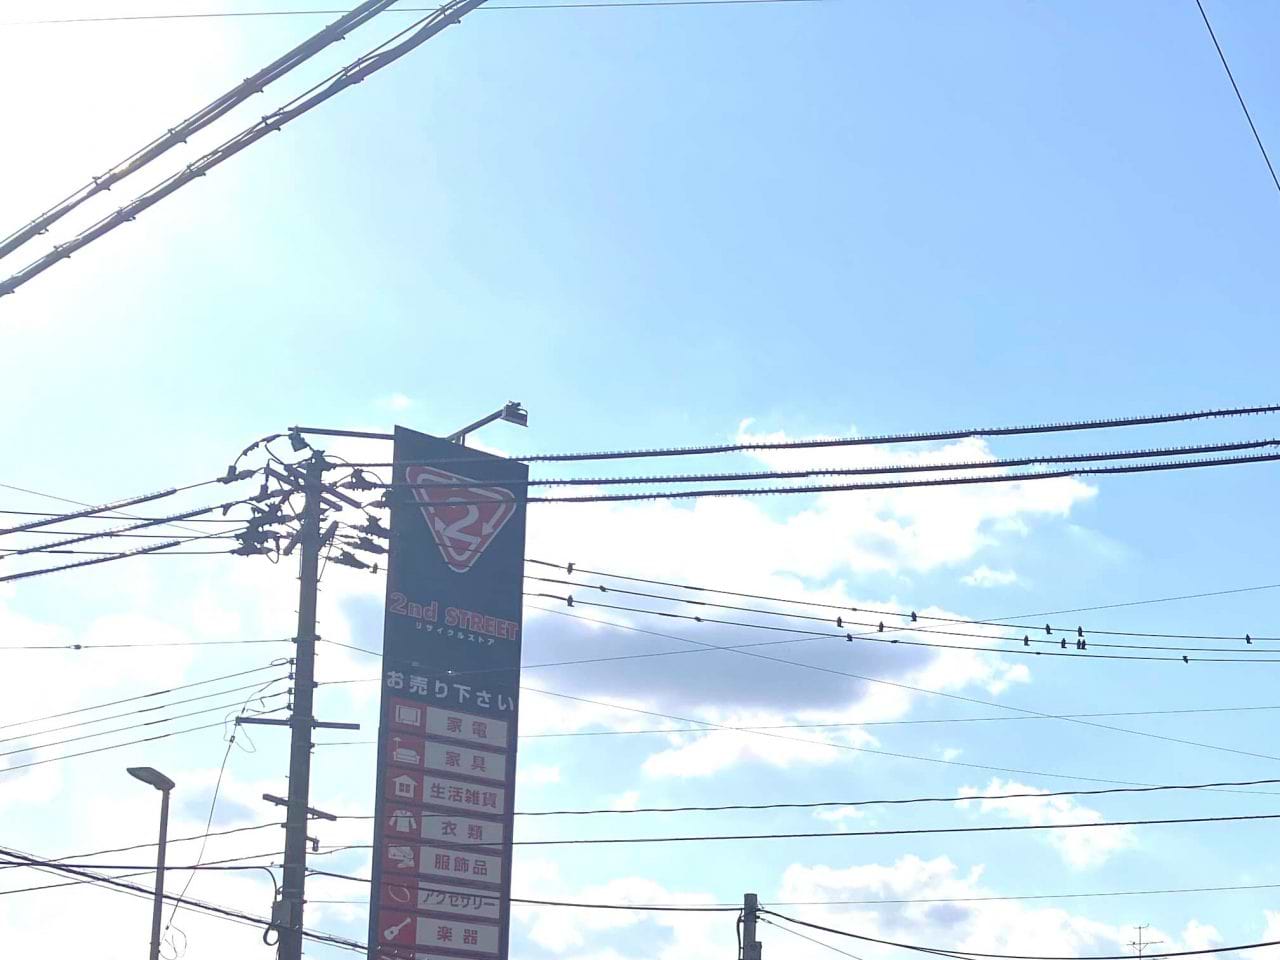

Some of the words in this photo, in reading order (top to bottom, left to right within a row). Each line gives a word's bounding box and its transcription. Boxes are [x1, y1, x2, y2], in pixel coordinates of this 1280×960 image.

[390, 592, 438, 622] 2nd
[445, 607, 519, 640] STREET
[416, 622, 495, 646] リサイクルストア
[386, 670, 514, 711] お売り下さい
[447, 716, 488, 739] 家電
[445, 751, 486, 772] 家具
[430, 782, 497, 808] 生活雑貨
[441, 821, 483, 841] 衣類
[434, 853, 488, 876] 服飾品
[423, 891, 495, 910] アクセサリー
[437, 926, 478, 945] 楽器
